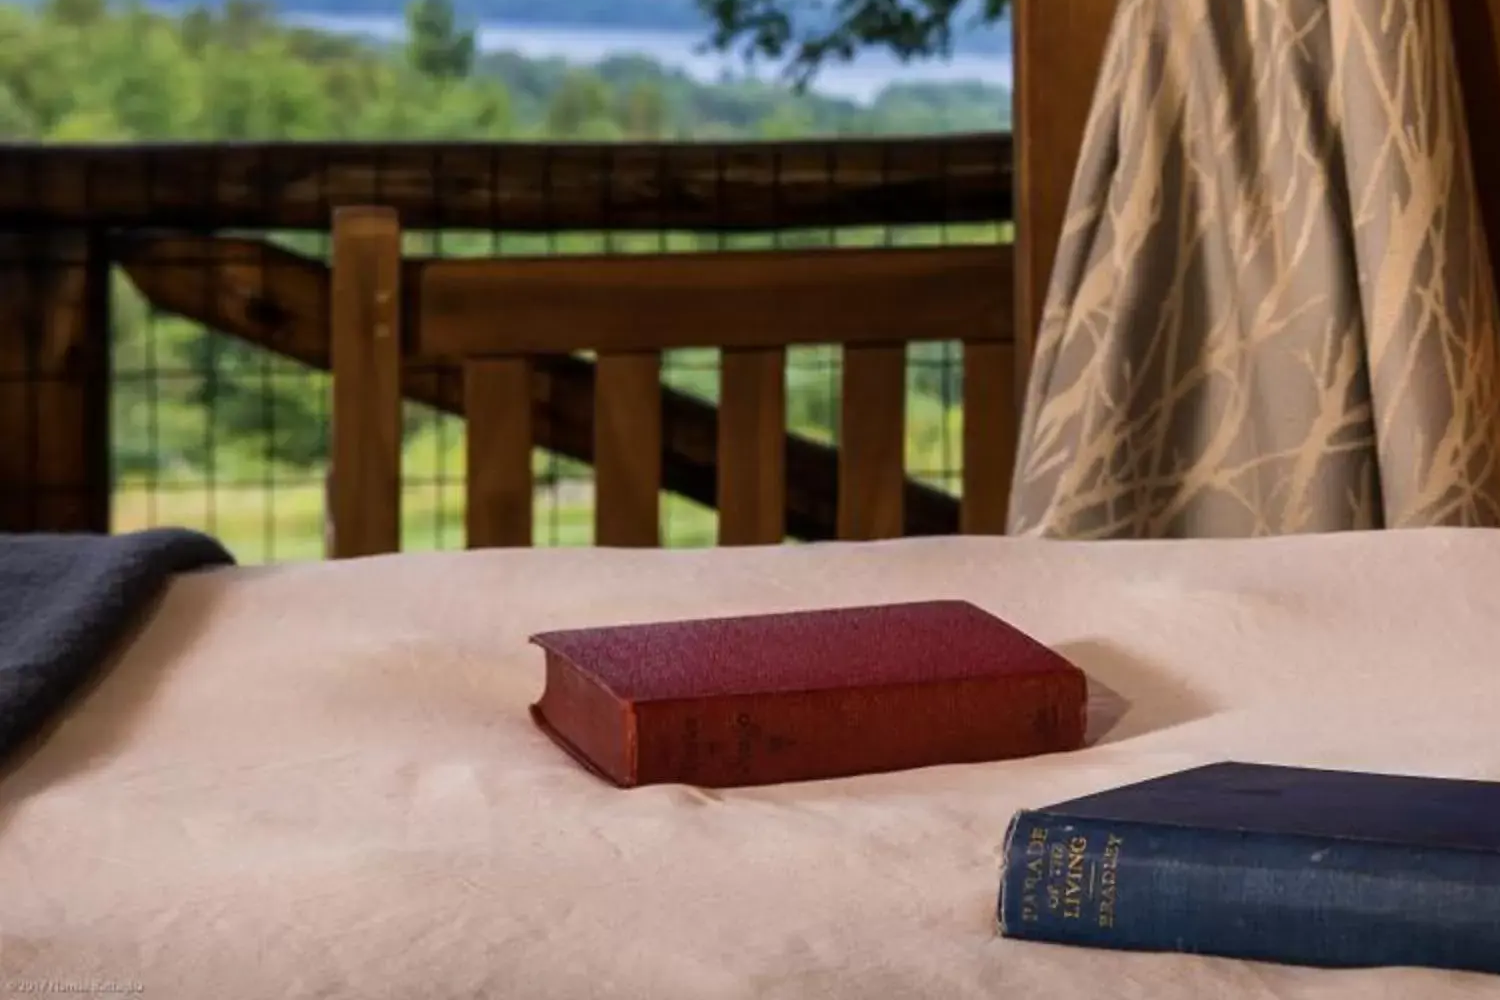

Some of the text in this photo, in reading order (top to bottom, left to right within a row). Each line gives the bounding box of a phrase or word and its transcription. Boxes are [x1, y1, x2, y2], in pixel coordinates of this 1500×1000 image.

[1022, 827, 1048, 920] PARADE
[1064, 837, 1087, 918] LIVING
[1099, 832, 1124, 928] BRADLEY
